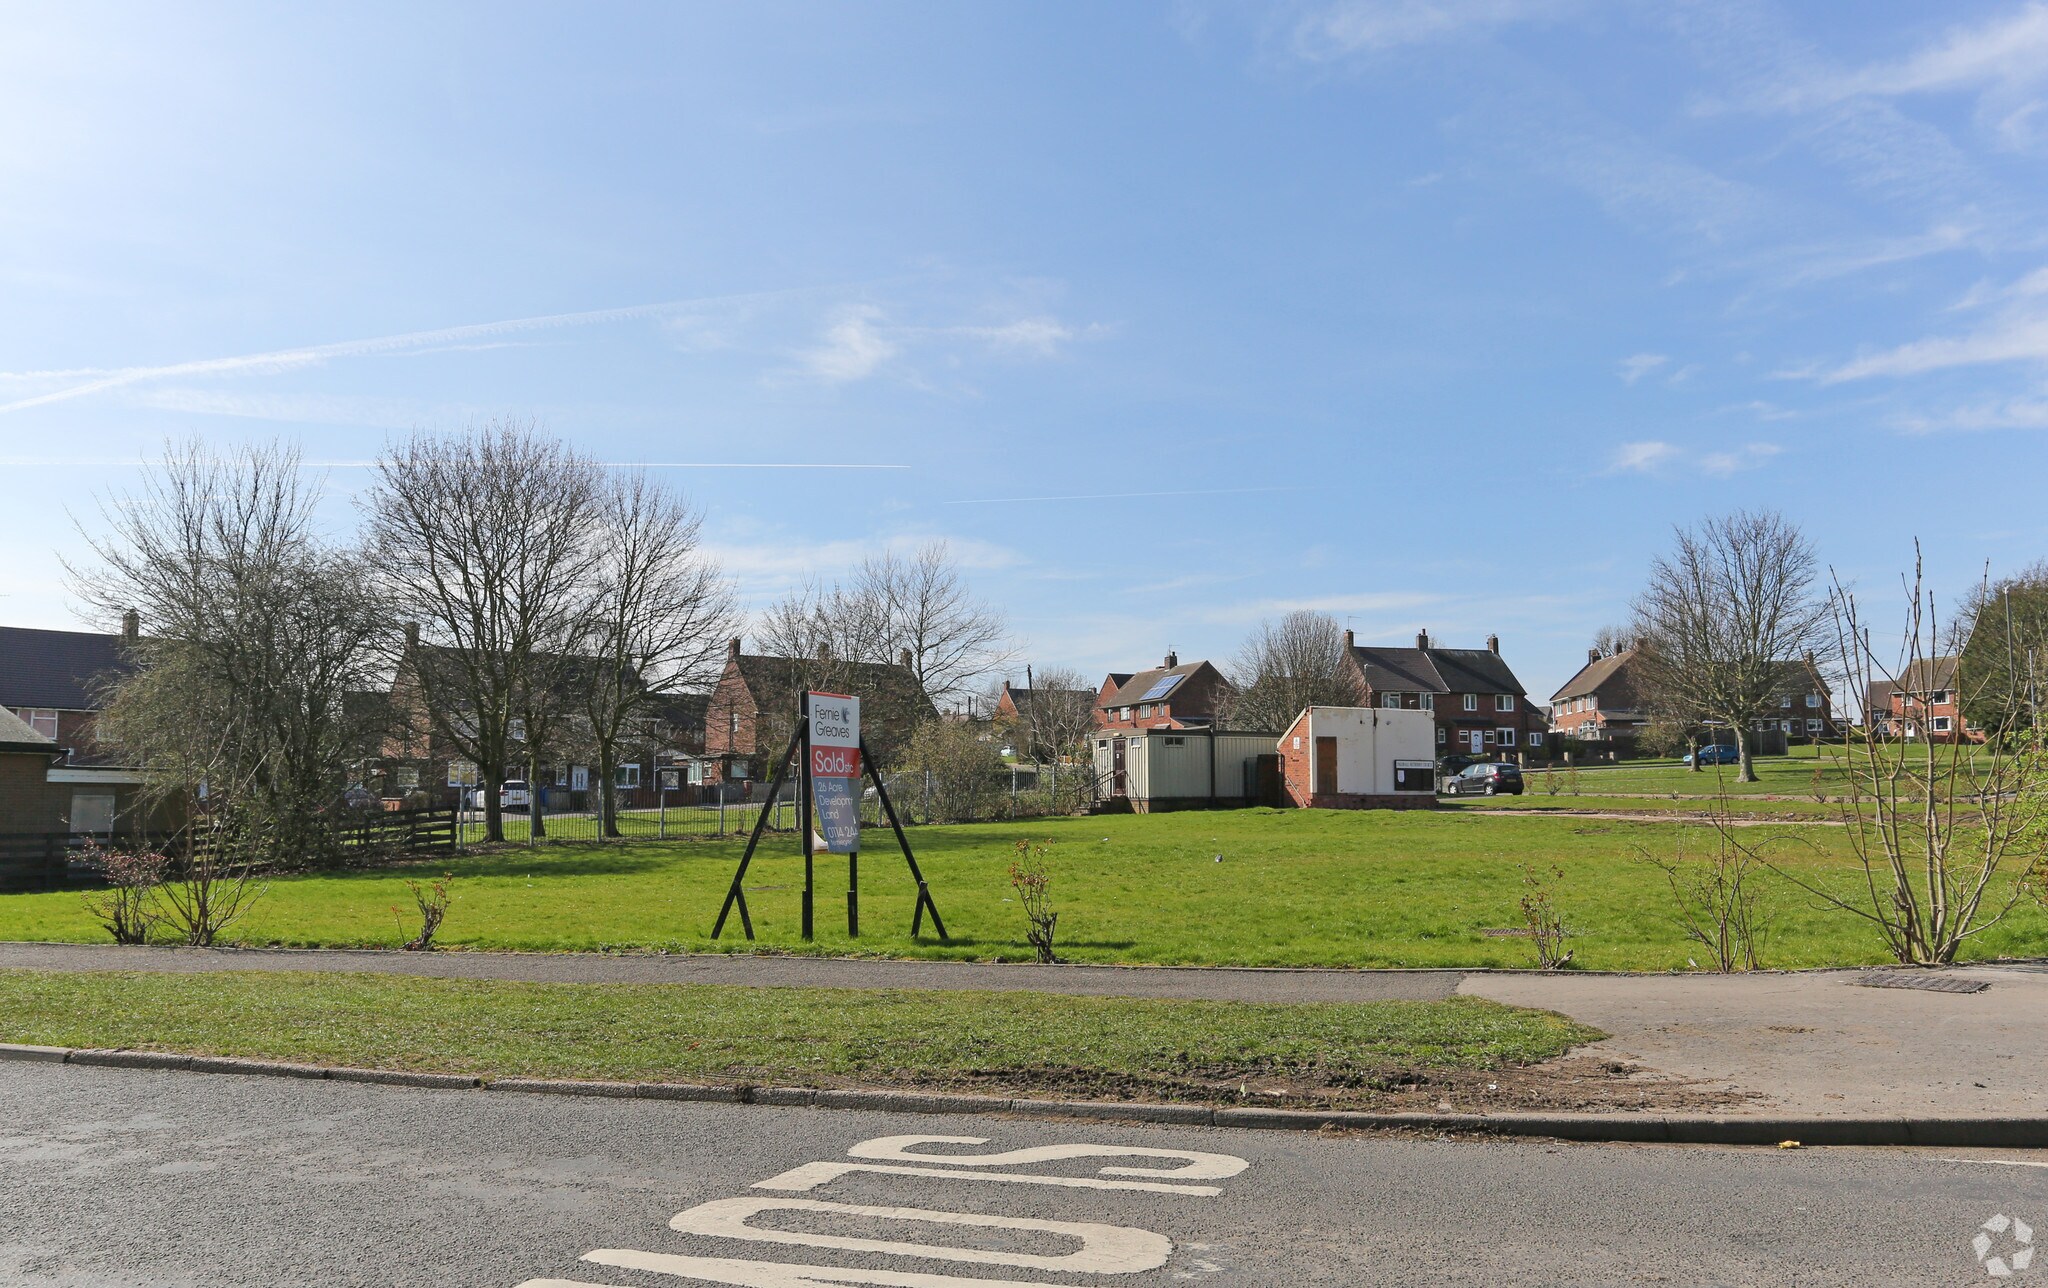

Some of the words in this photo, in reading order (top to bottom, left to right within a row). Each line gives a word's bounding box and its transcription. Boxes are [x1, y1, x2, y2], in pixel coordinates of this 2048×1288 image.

[815, 704, 840, 721] Fernie
[815, 721, 850, 738] Greaves
[815, 750, 845, 773] Sold
